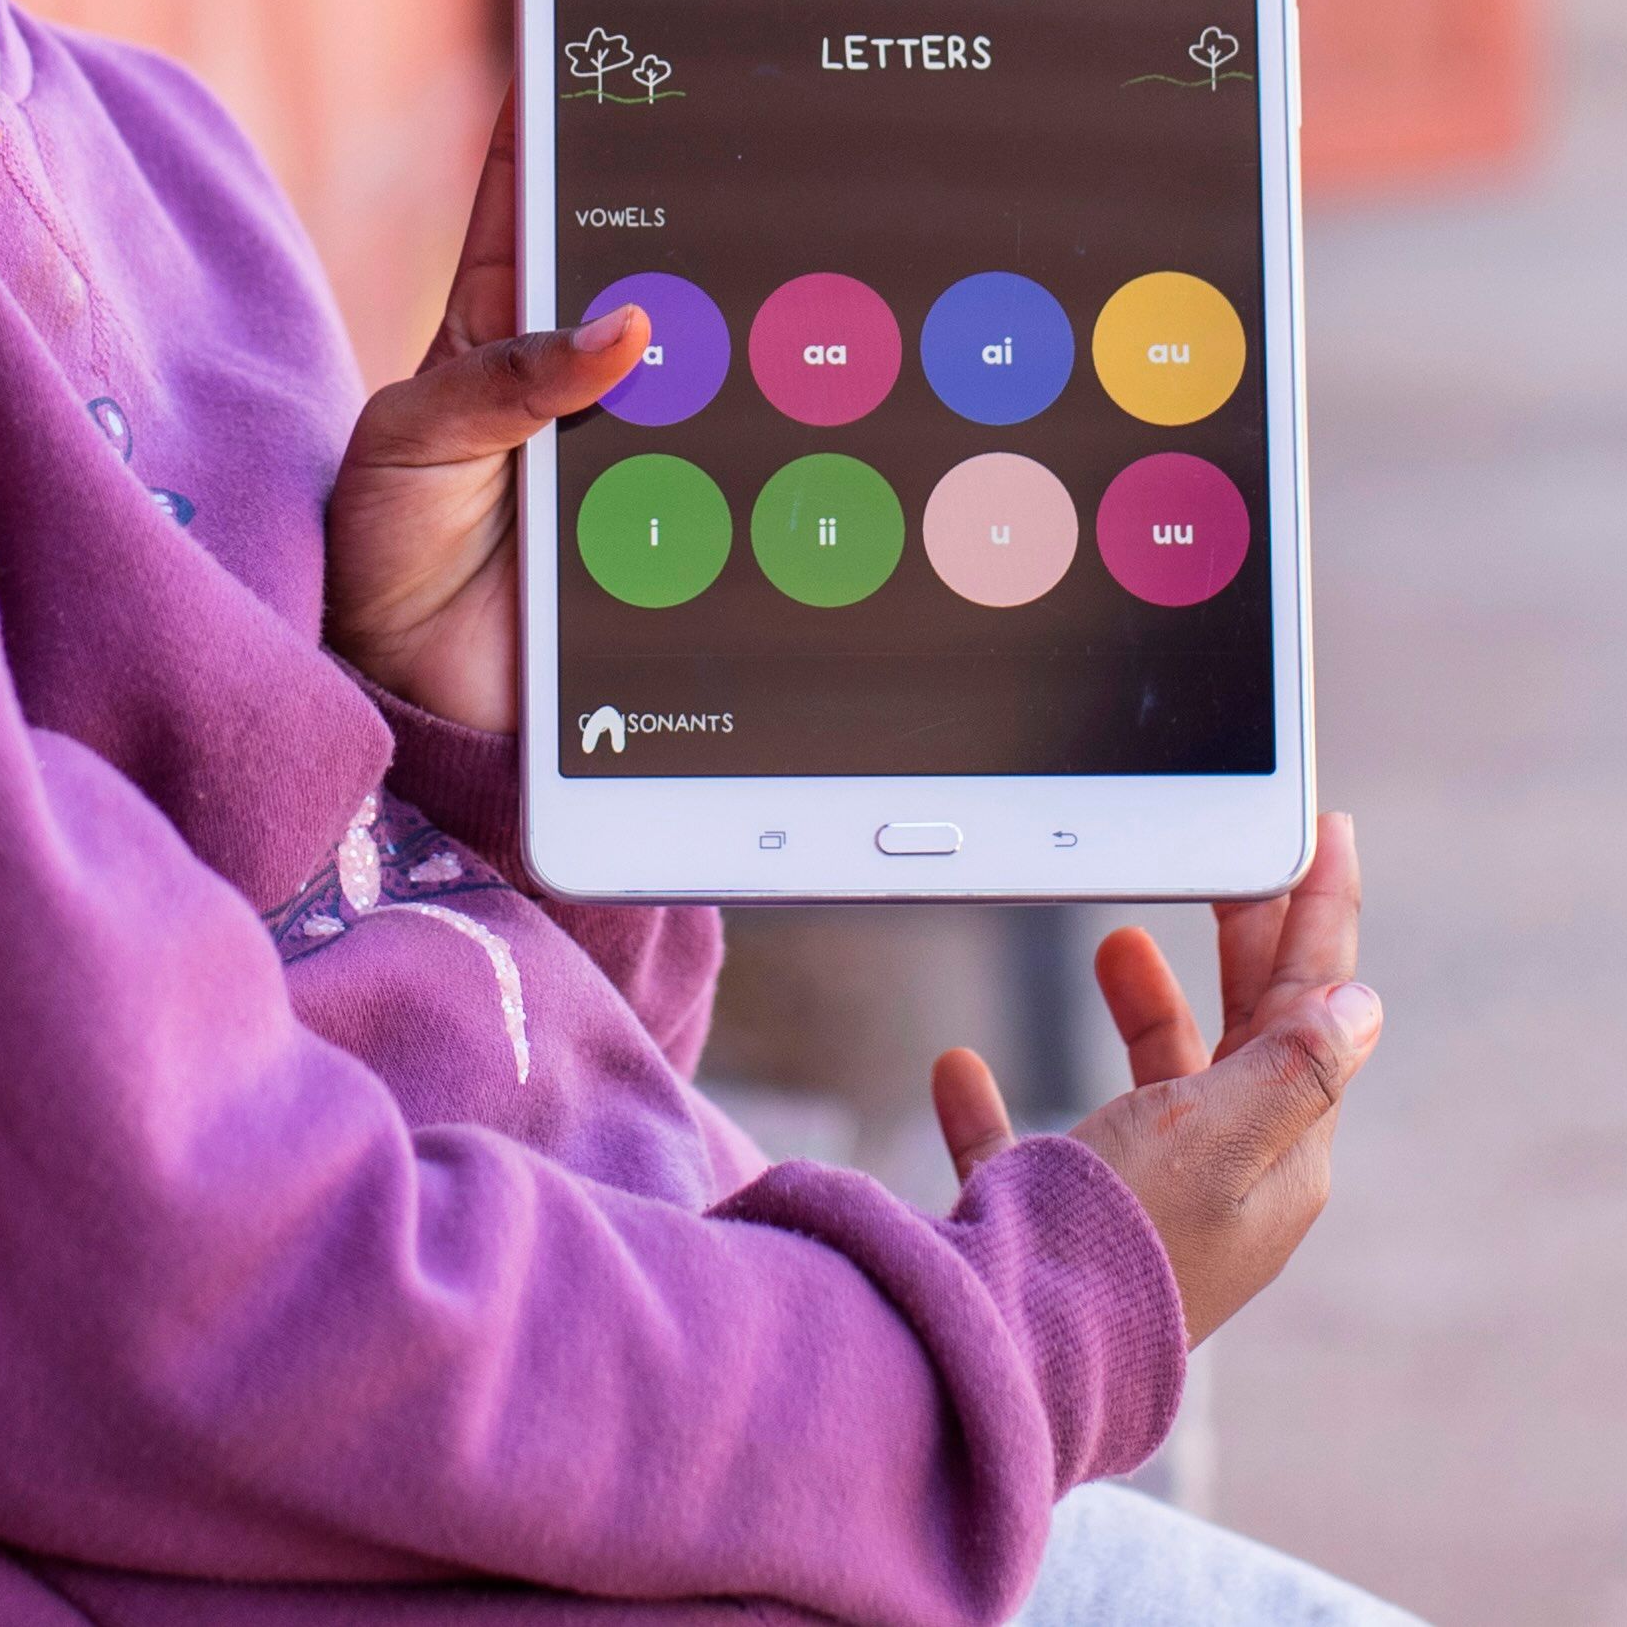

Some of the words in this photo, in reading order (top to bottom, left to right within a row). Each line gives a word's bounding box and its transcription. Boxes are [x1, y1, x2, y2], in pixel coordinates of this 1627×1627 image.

[821, 34, 992, 70] LETTERS
[575, 207, 666, 228] VOWELS
[642, 345, 663, 366] a
[803, 345, 847, 366] aa
[981, 336, 1012, 366] ai
[1147, 344, 1190, 365] au
[650, 517, 659, 547] i
[818, 517, 837, 547] ii
[990, 524, 1010, 545] u
[1152, 524, 1194, 546] uu
[578, 713, 734, 734] CSONANTS
